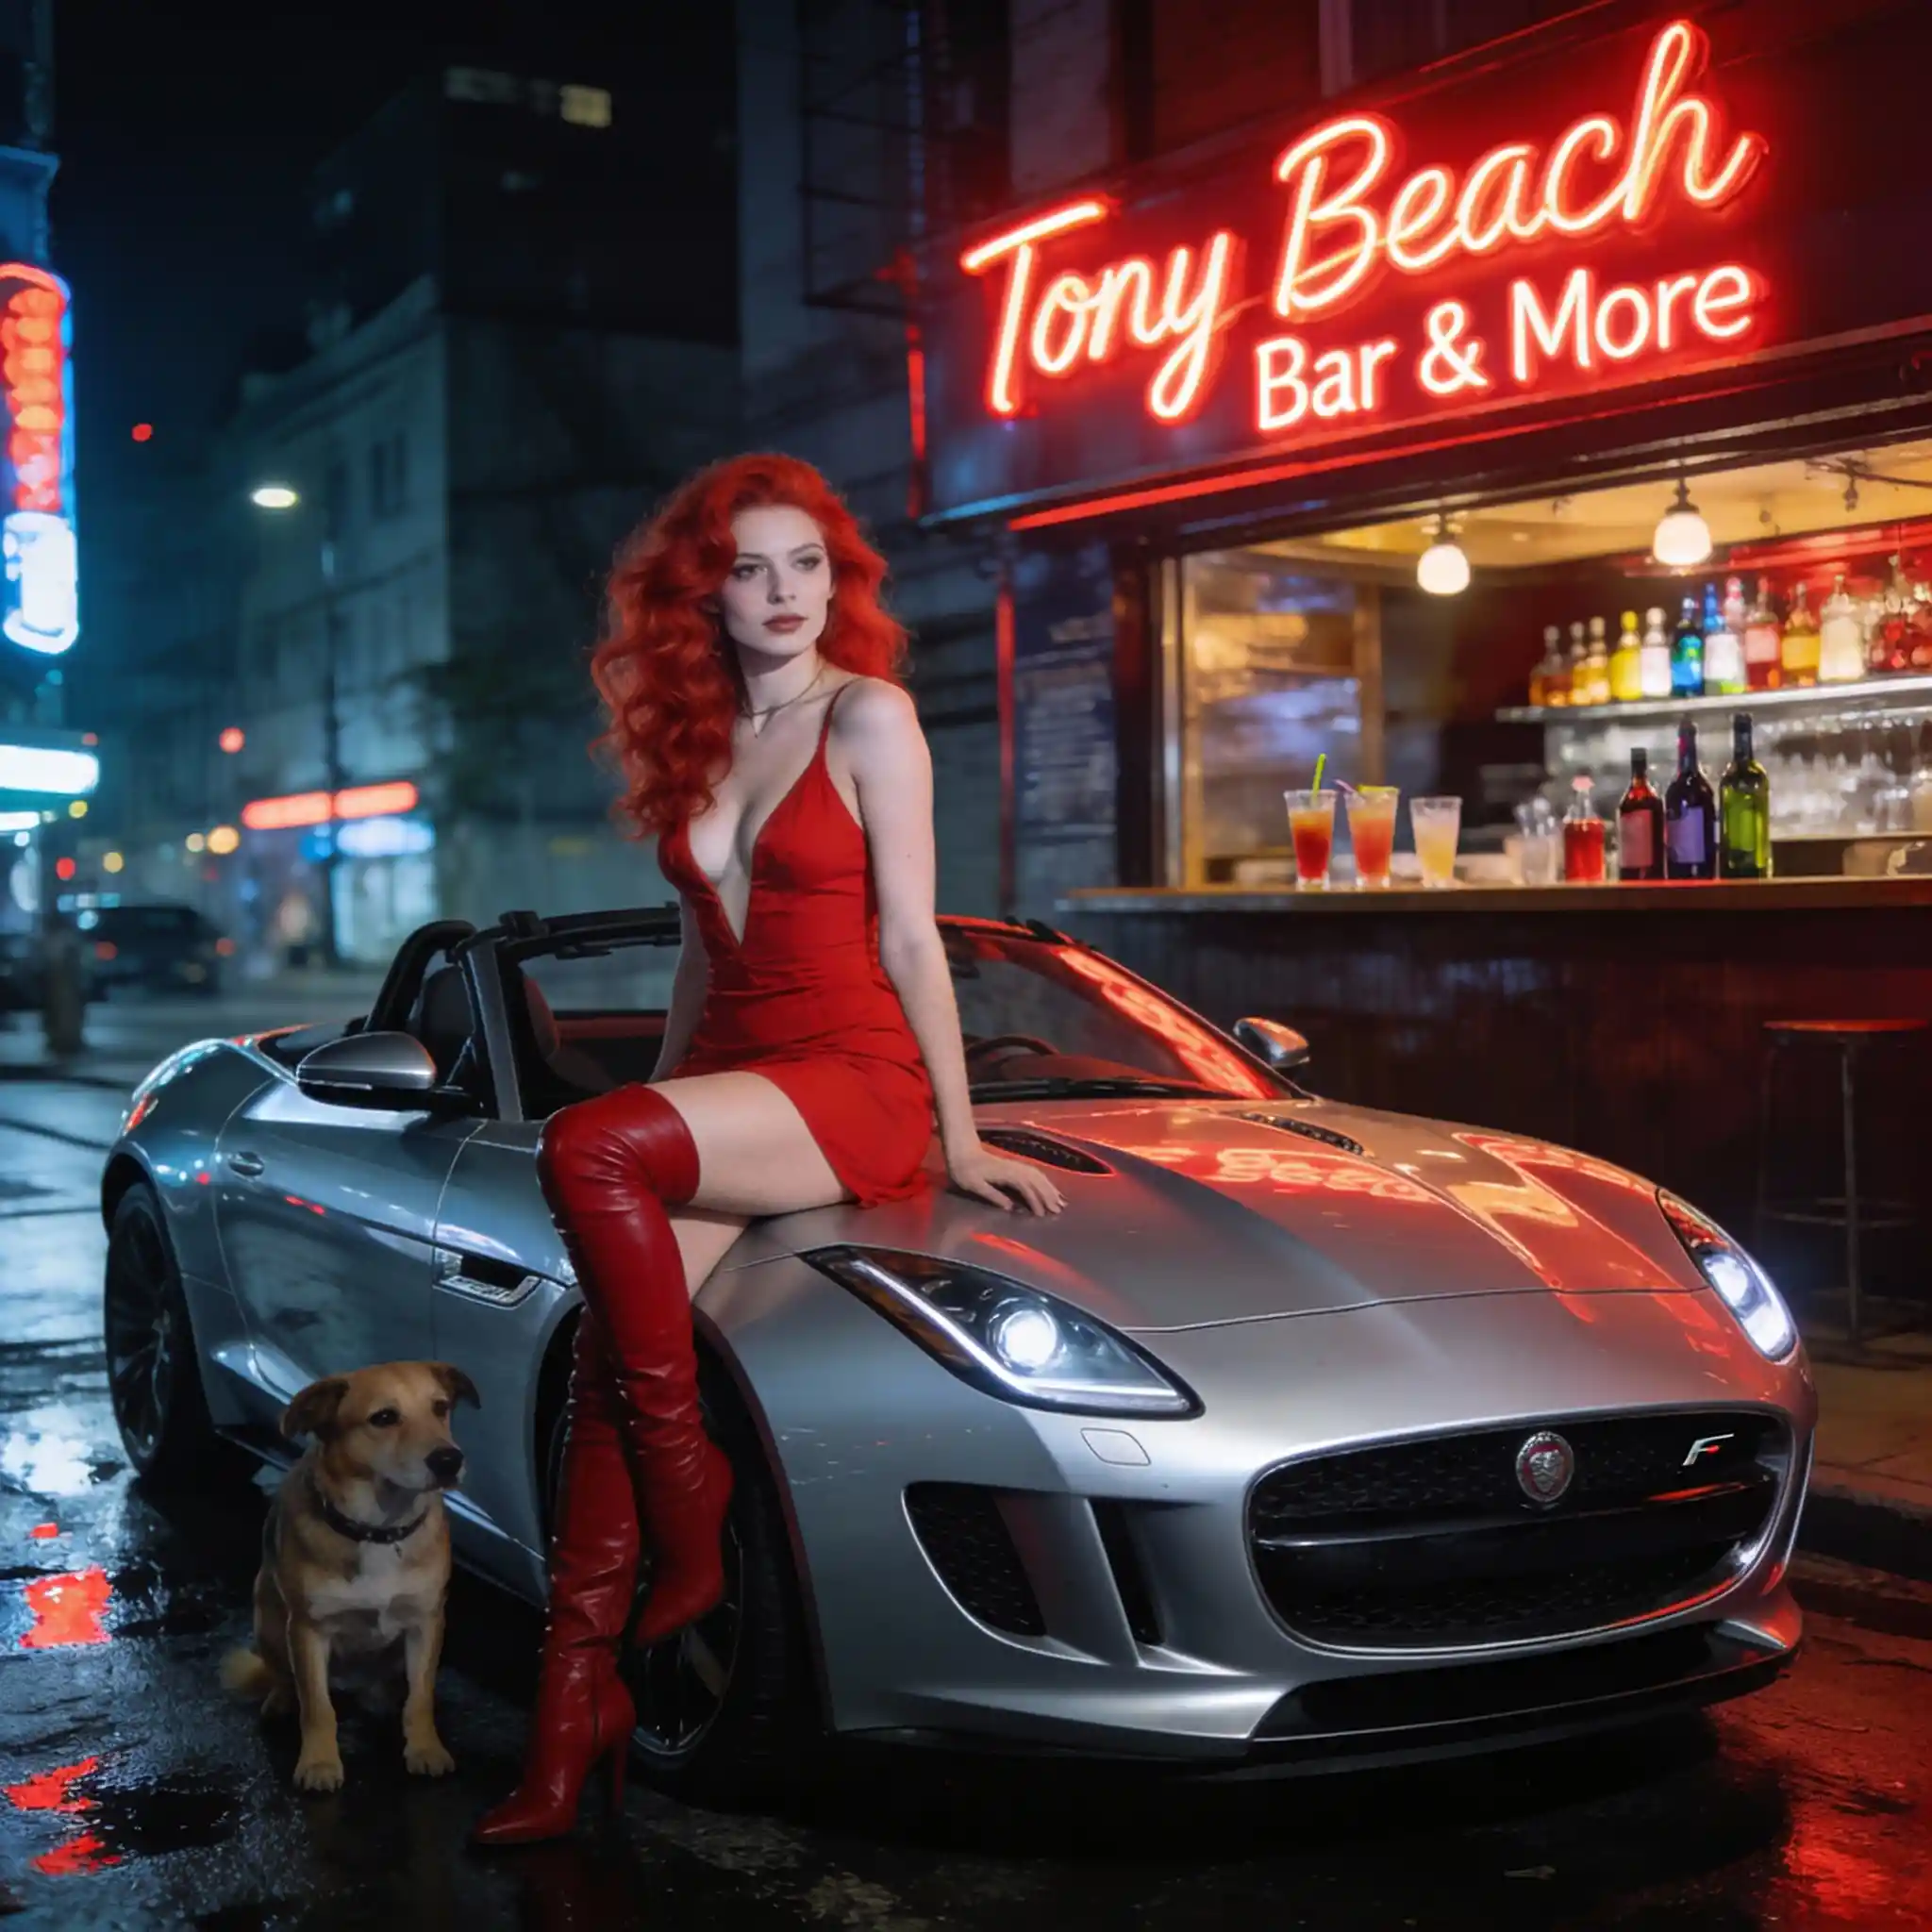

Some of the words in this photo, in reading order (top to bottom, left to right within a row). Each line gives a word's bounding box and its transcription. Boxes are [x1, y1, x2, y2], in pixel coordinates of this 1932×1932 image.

[961, 200, 1237, 419] Tony
[1277, 21, 1758, 317] Beach
[1257, 338, 1396, 430] Bar
[1419, 302, 1489, 395] &
[1511, 266, 1754, 382] More
